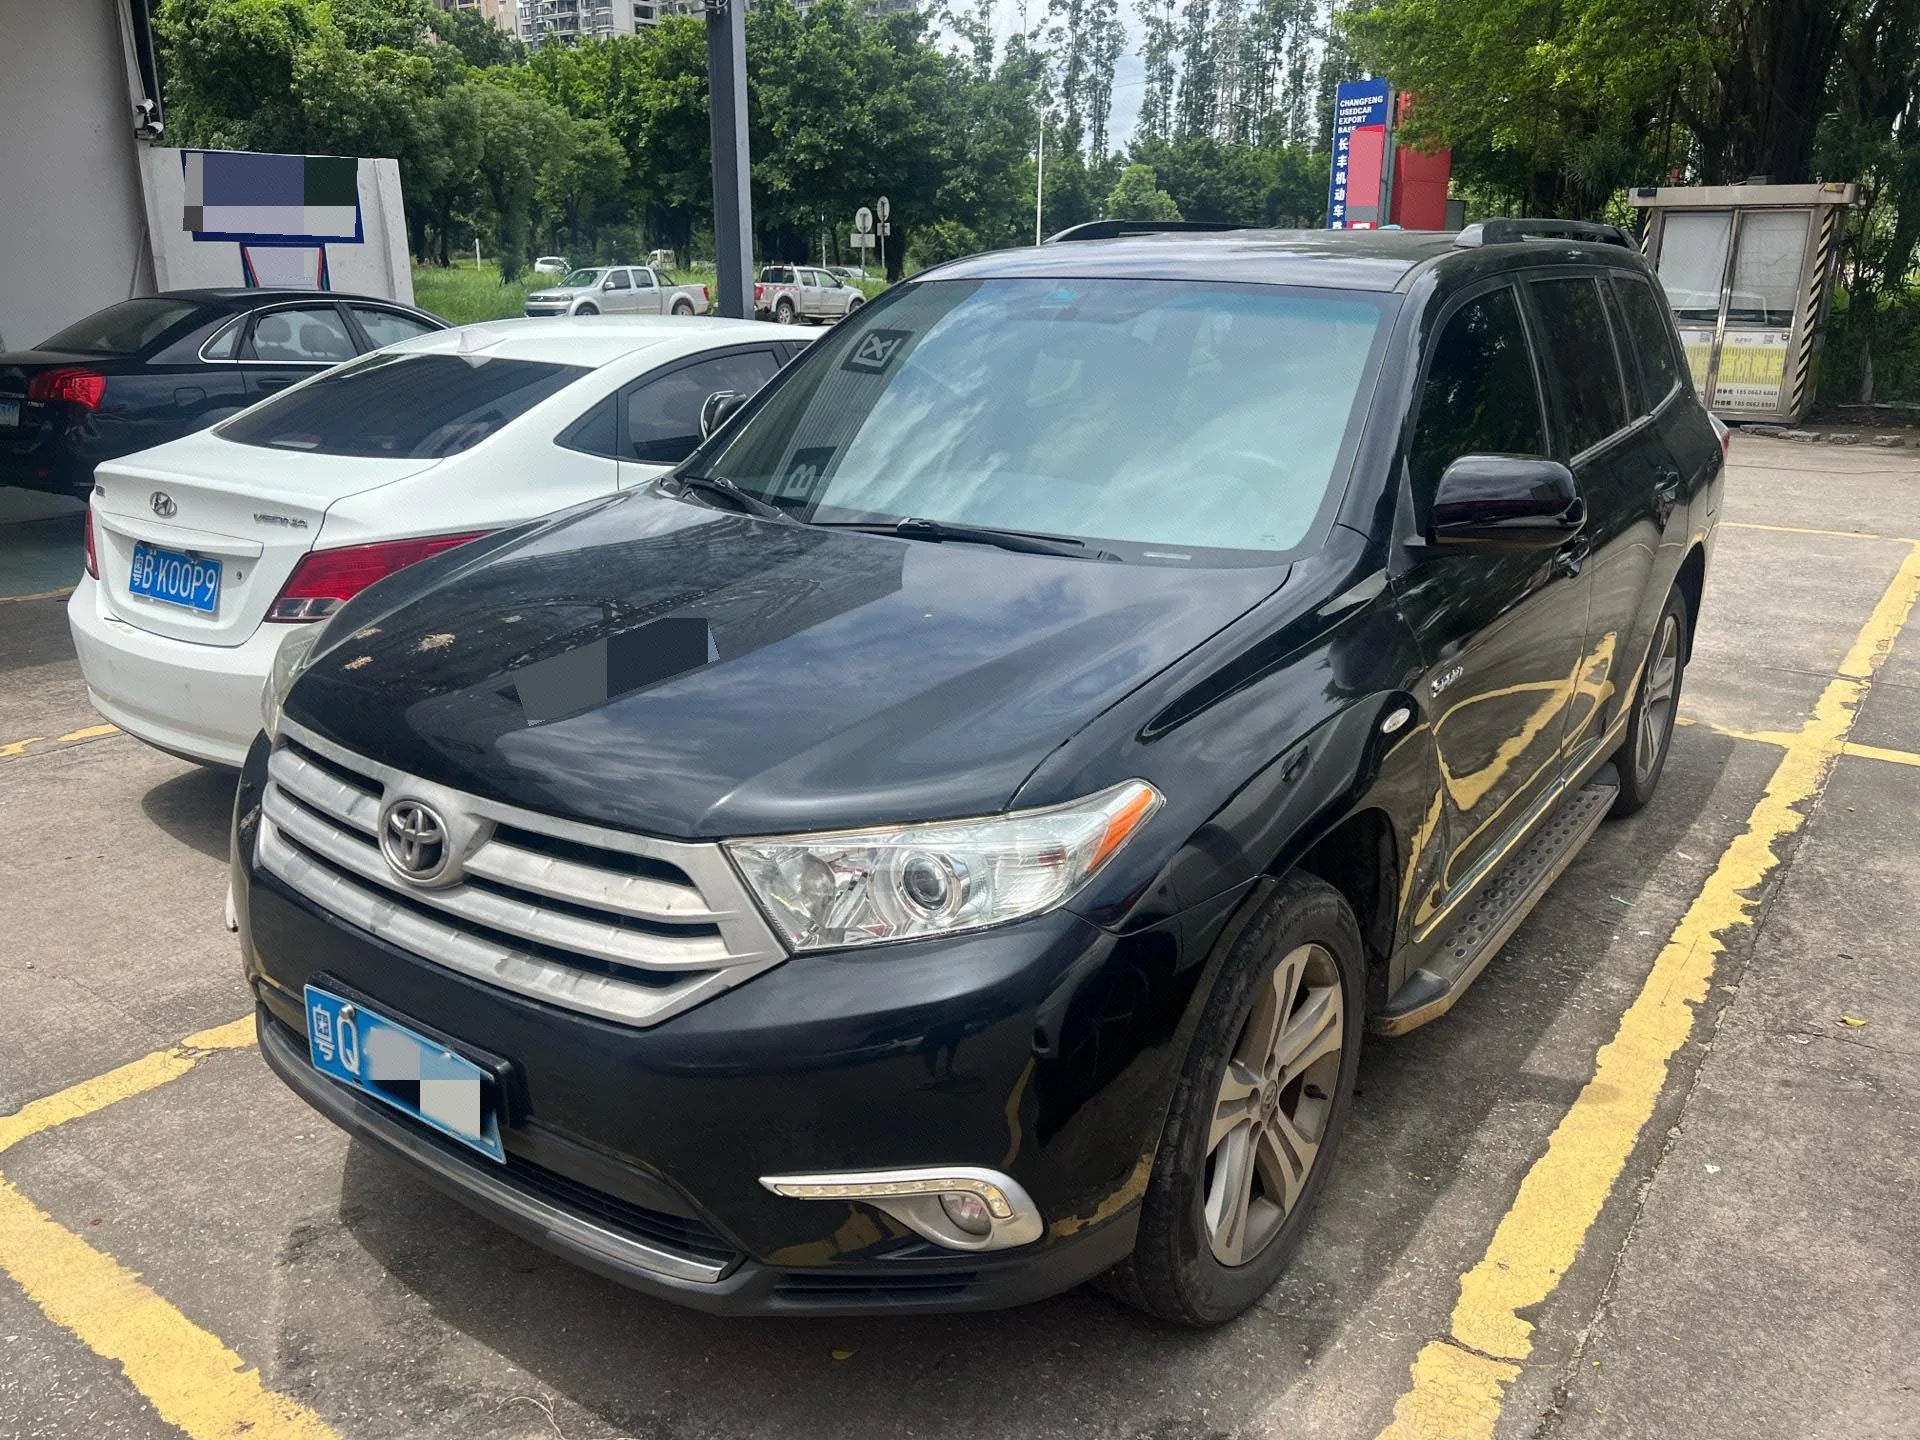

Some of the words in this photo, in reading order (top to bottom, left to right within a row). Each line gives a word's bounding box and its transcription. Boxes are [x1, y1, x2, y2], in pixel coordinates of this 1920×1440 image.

[1340, 95, 1384, 107] CHANGFENG
[1339, 106, 1372, 116] USEDCAR
[1338, 115, 1367, 125] EXPORT
